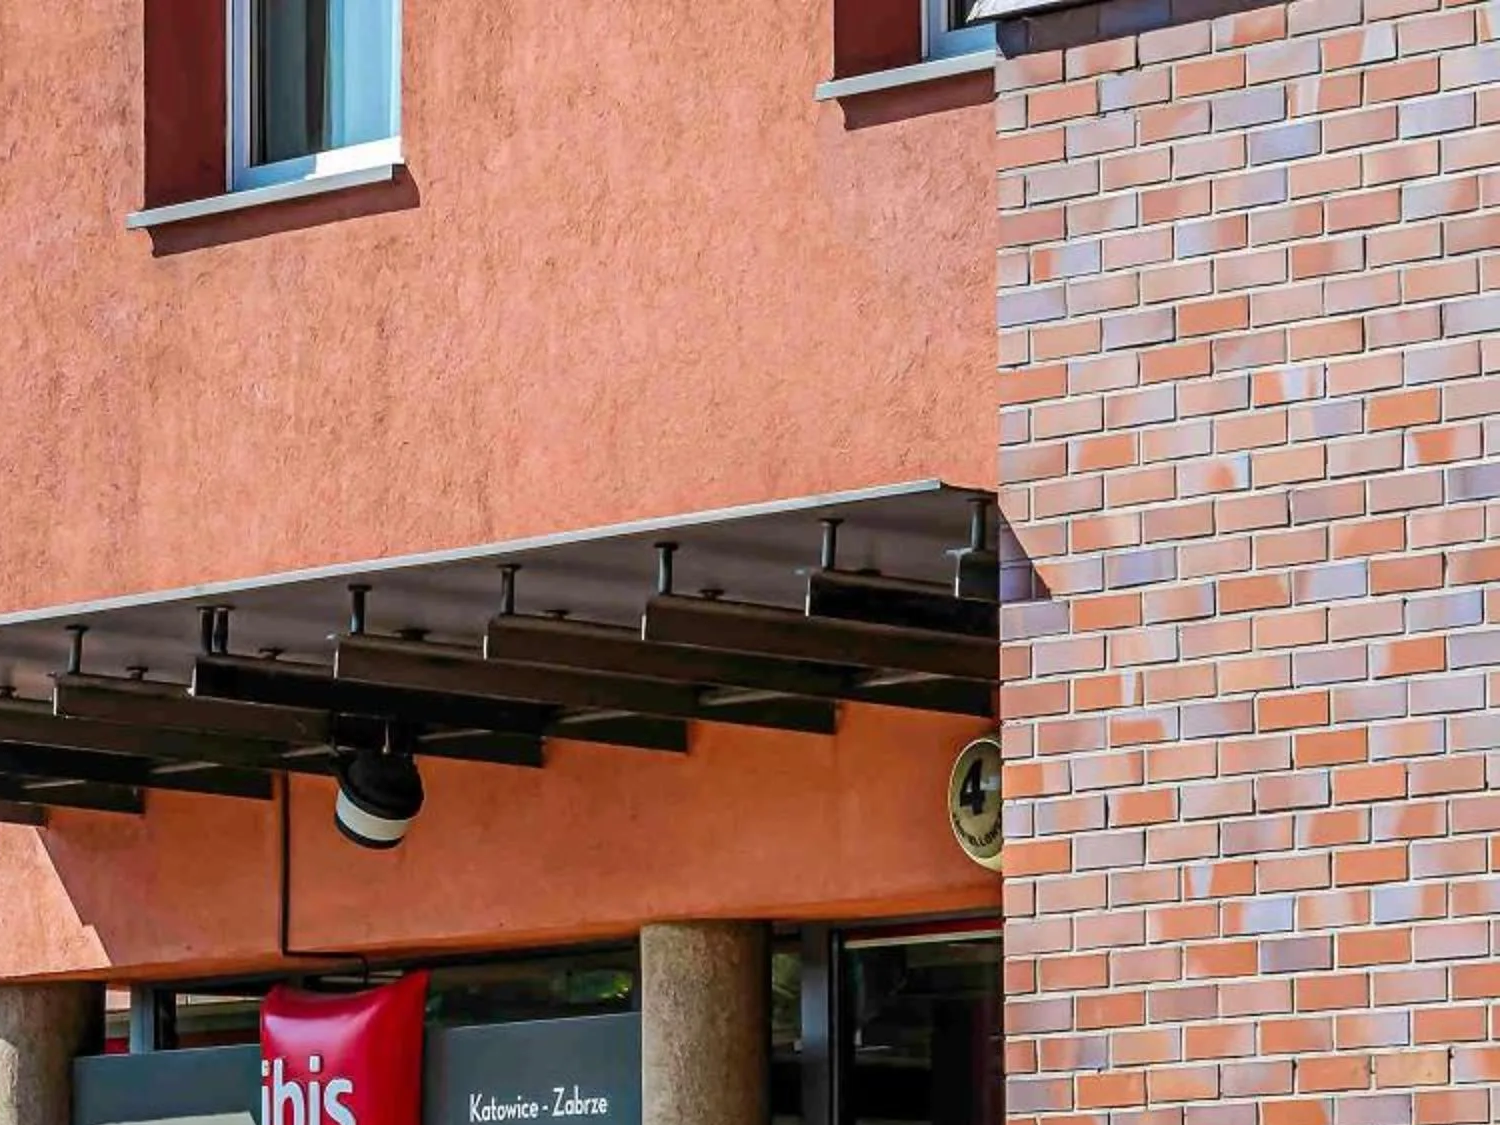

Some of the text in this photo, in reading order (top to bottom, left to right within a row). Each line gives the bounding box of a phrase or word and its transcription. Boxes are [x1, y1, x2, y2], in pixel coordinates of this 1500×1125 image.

[960, 758, 986, 817] 4
[469, 1092, 539, 1123] Katowice
[552, 1084, 609, 1117] Zabrze
